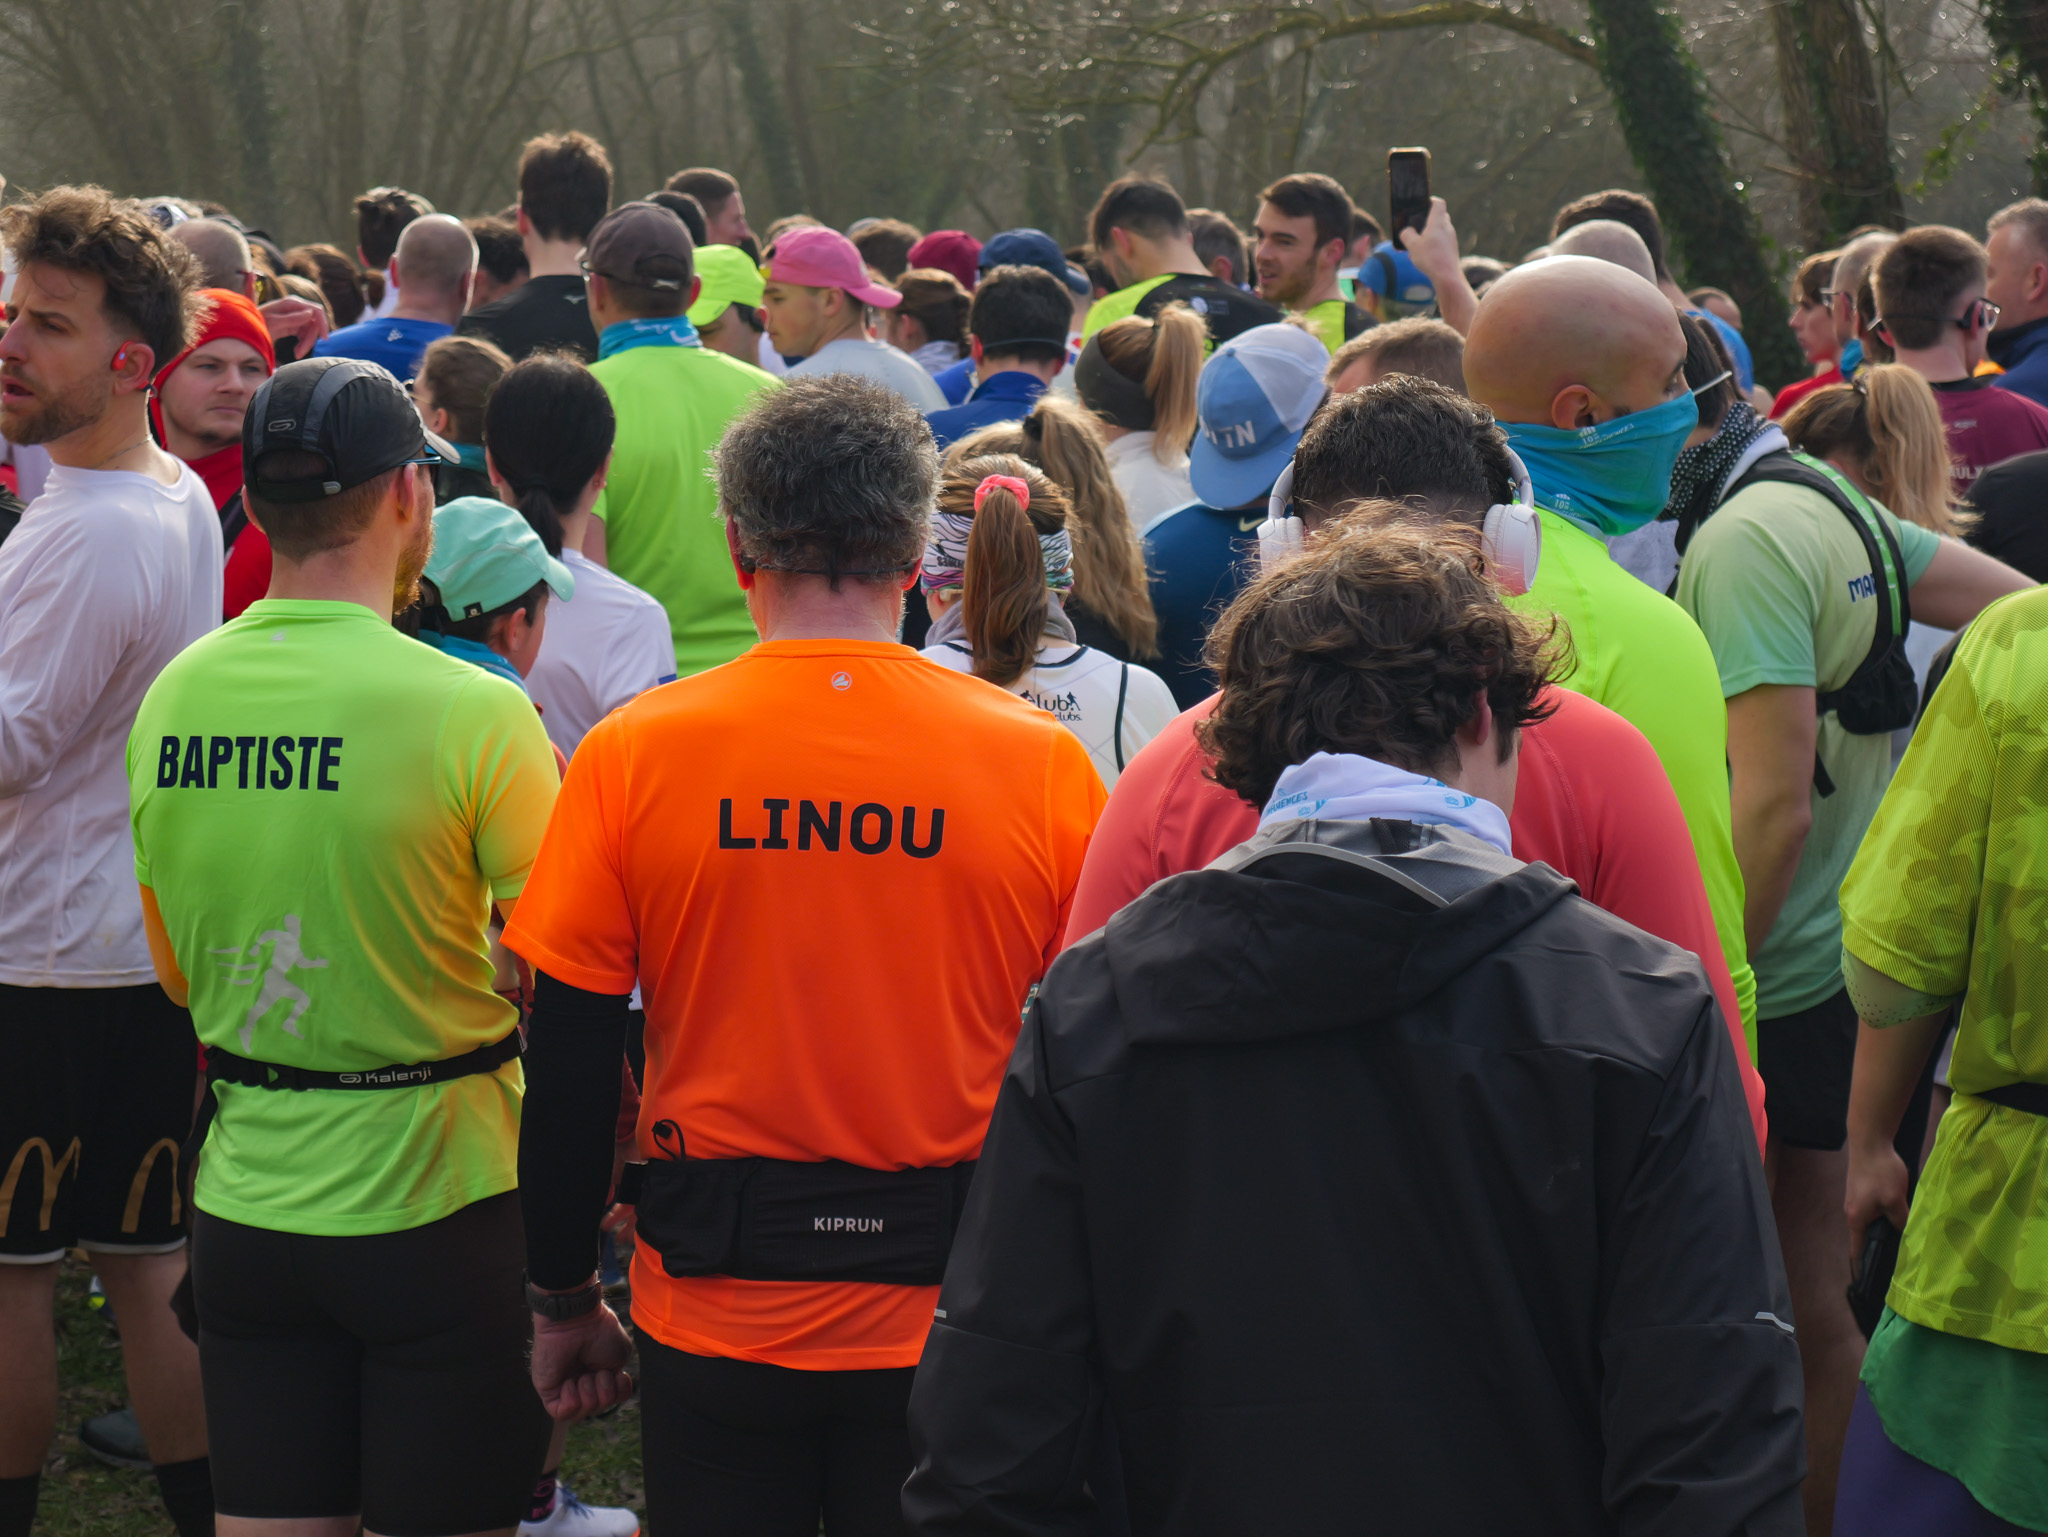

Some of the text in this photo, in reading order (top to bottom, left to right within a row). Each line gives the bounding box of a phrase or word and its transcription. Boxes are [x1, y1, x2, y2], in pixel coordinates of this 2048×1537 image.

[157, 736, 343, 791] BAPTISTE
[719, 798, 945, 859] LINOU
[365, 1066, 431, 1084] Kalenji
[814, 1217, 884, 1233] KIPRUN
